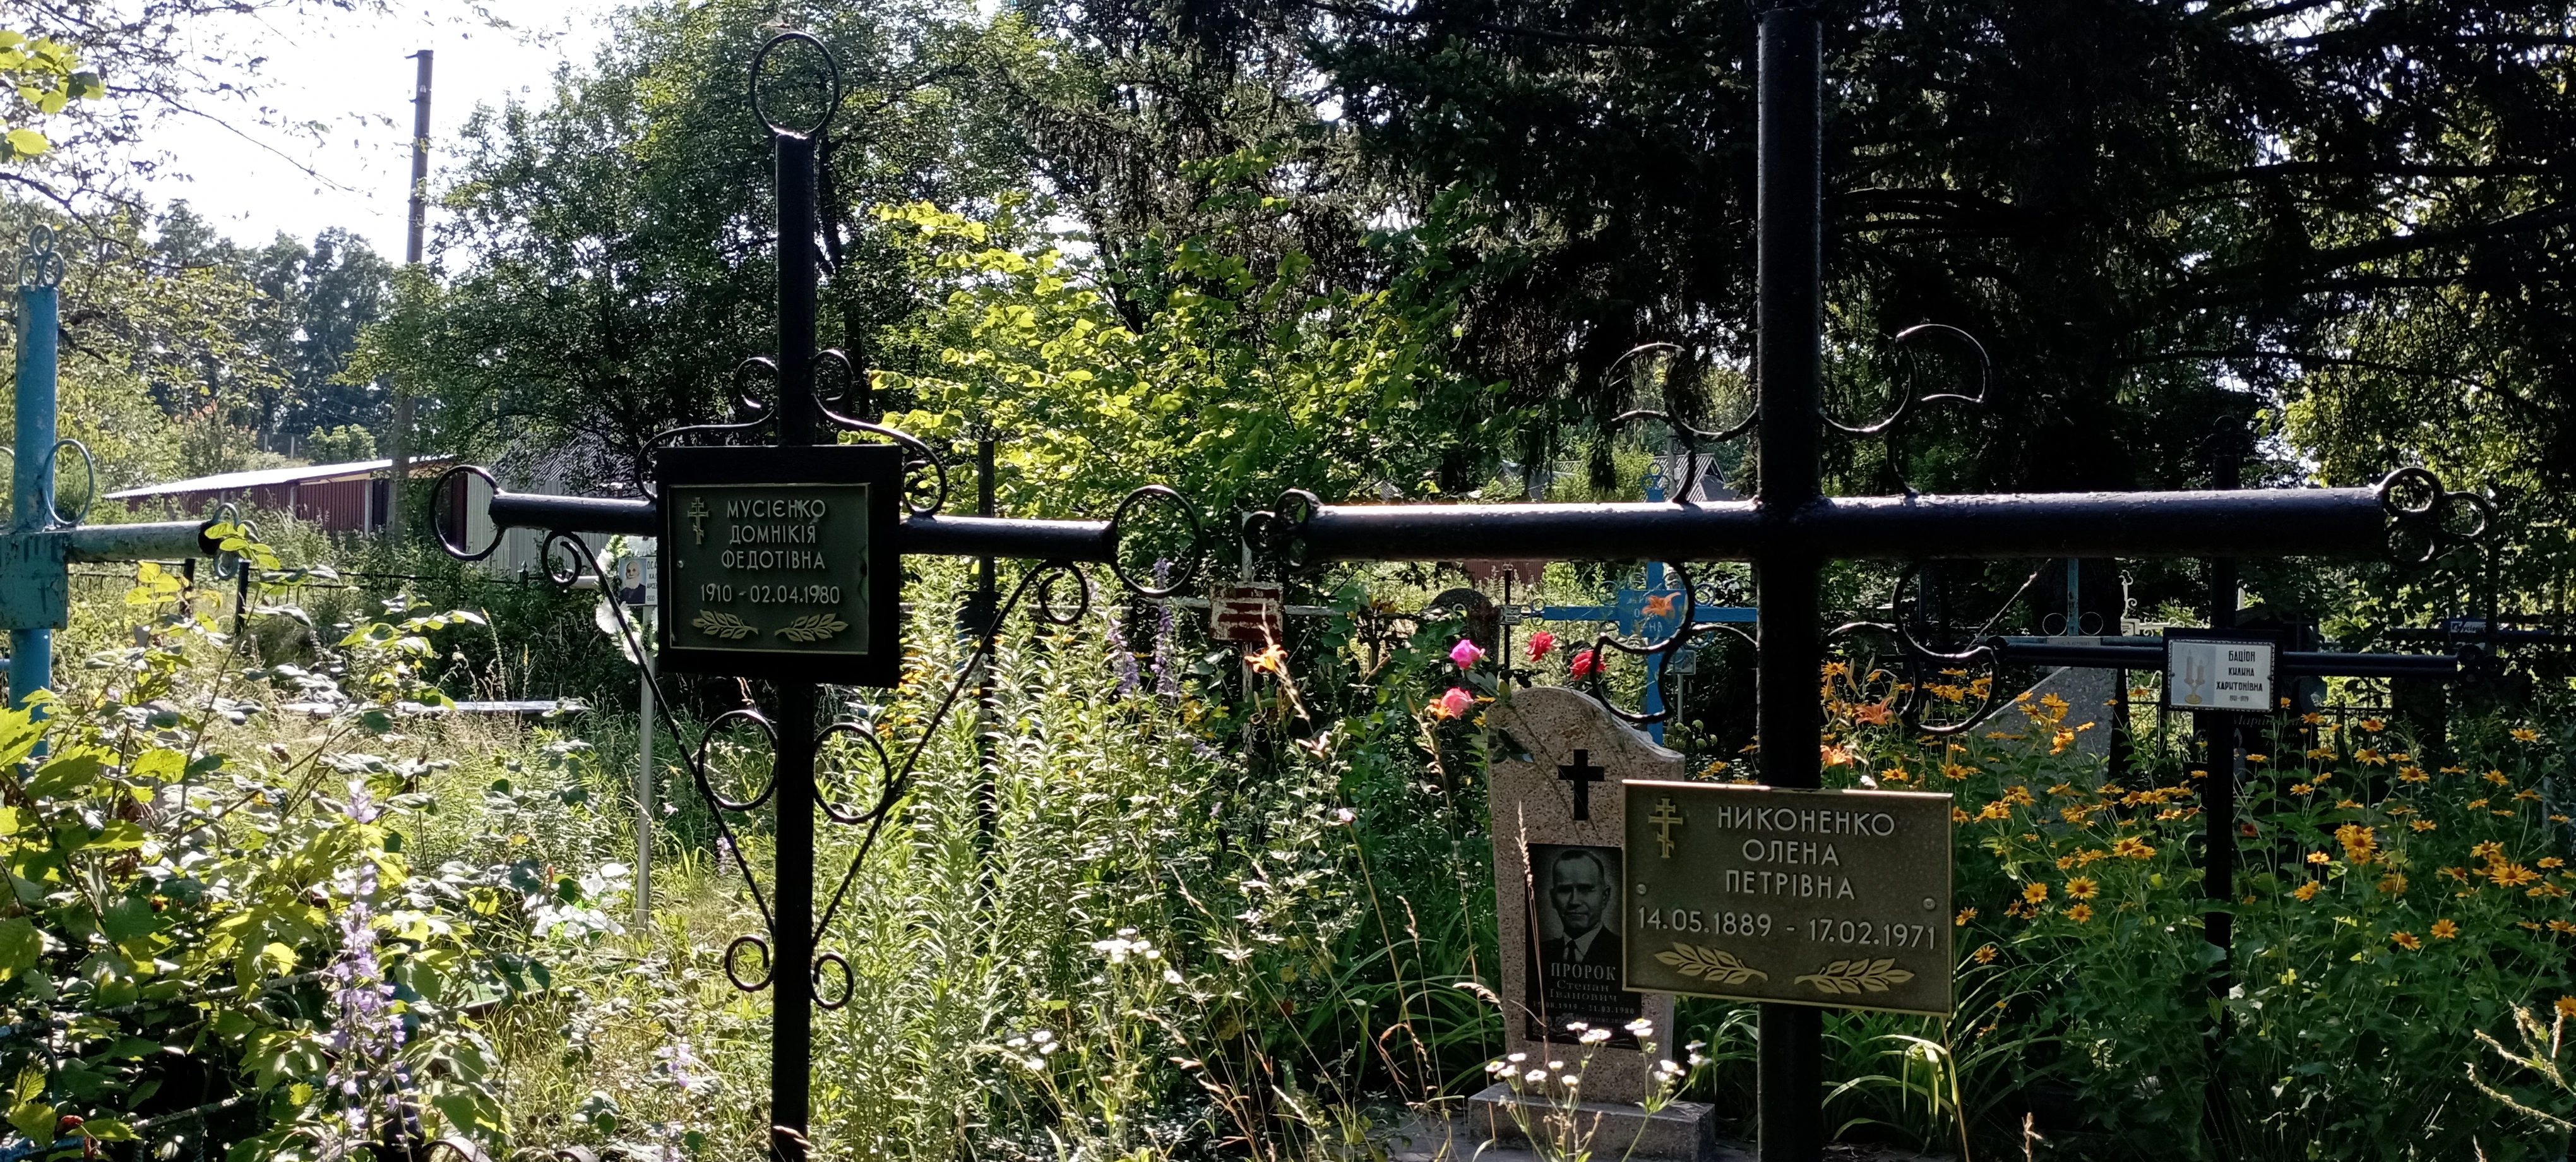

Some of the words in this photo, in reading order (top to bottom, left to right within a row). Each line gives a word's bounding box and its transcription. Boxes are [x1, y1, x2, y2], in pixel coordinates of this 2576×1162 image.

[727, 499, 826, 518] МУСІЄНКО
[729, 524, 816, 544] ДОМНІКІЯ
[721, 549, 826, 570] ФЕДОТІВНА
[701, 584, 732, 602] 1910
[750, 585, 840, 604] 02.04.1980
[2228, 649, 2255, 662] БАЦІОН
[2228, 667, 2255, 676] КИЛИНА
[2216, 681, 2263, 692] ХАРИТОНІВНА
[1717, 805, 1895, 837] НИКОНЕНКО
[1743, 838, 1839, 866] ОЛЕНА
[1726, 869, 1855, 900] ПЕТРІВНА
[1638, 906, 1772, 937] 14.05.1889
[1810, 918, 1935, 949] 17.02.1971
[1551, 962, 1616, 981] ПРОРОК
[1549, 988, 1617, 1002] Іванович
[1557, 979, 1609, 992] Степан
